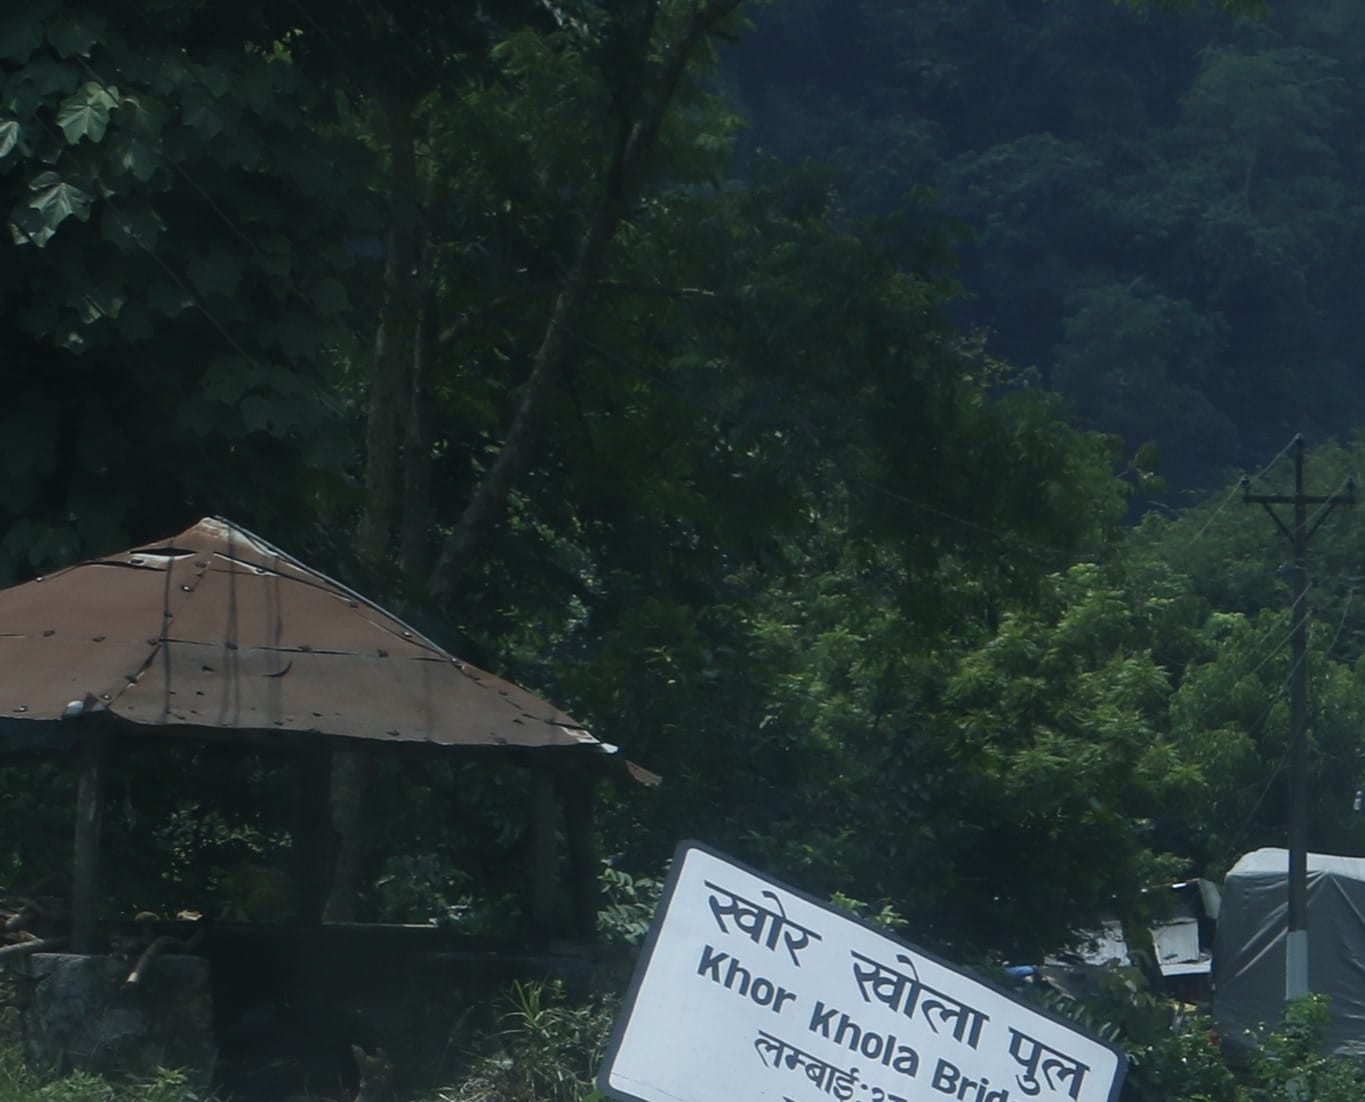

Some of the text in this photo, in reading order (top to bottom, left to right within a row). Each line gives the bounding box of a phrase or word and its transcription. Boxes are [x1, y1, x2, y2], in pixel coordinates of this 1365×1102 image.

[697, 945, 796, 1013] Khor
[808, 1002, 919, 1078] Khola
[851, 951, 990, 1049] खोला
[1008, 1026, 1090, 1101] पुल
